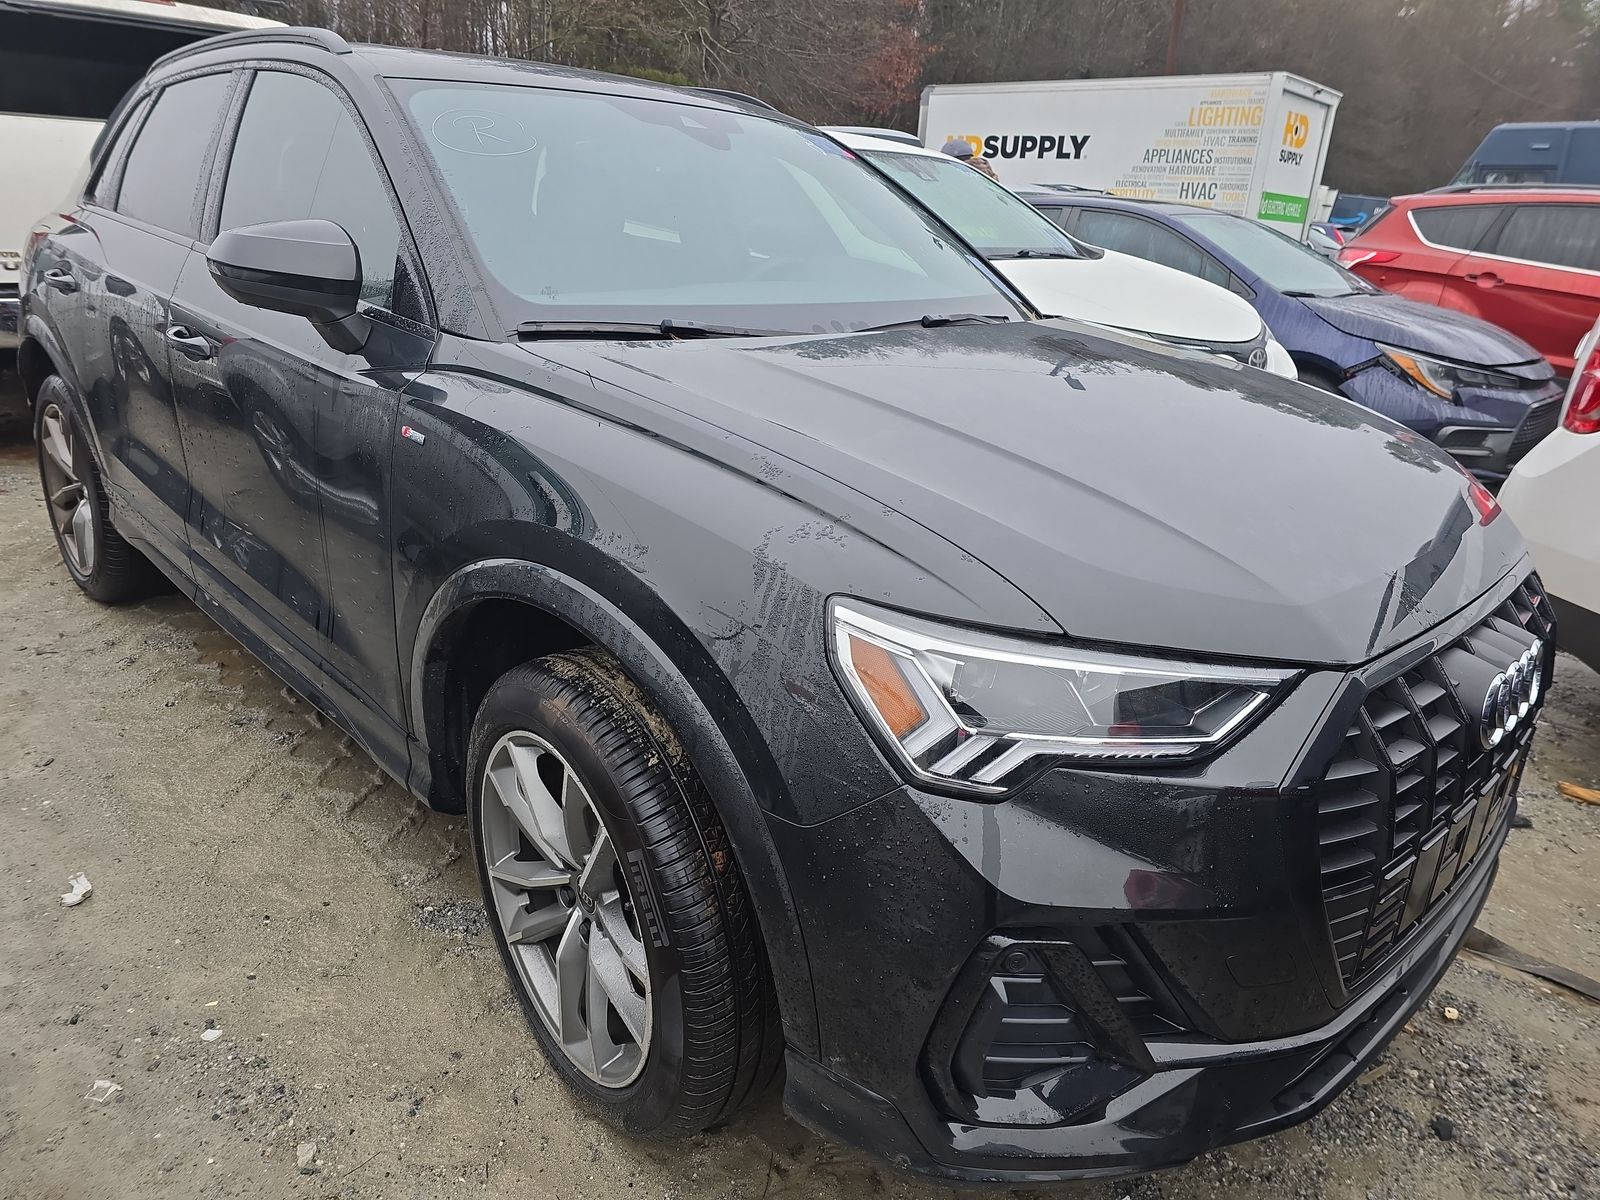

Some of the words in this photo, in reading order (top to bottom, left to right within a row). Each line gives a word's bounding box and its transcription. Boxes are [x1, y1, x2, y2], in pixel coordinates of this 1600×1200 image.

[1188, 106, 1264, 127] LIGHTING
[452, 115, 512, 147] R
[1164, 128, 1204, 138] MULTIFAMILY
[1282, 111, 1309, 149] HD
[1203, 136, 1226, 147] HVAC
[1227, 135, 1258, 144] TRAINING
[1142, 149, 1214, 164] APPLIANCES
[1279, 149, 1304, 166] SUPPLY
[1168, 165, 1216, 176] HARDWARE
[1115, 180, 1147, 188] ELECTRICAL
[1179, 182, 1218, 200] HVAC
[1104, 187, 1157, 198] OSPITALITY
[626, 848, 670, 948] PIRELLI
